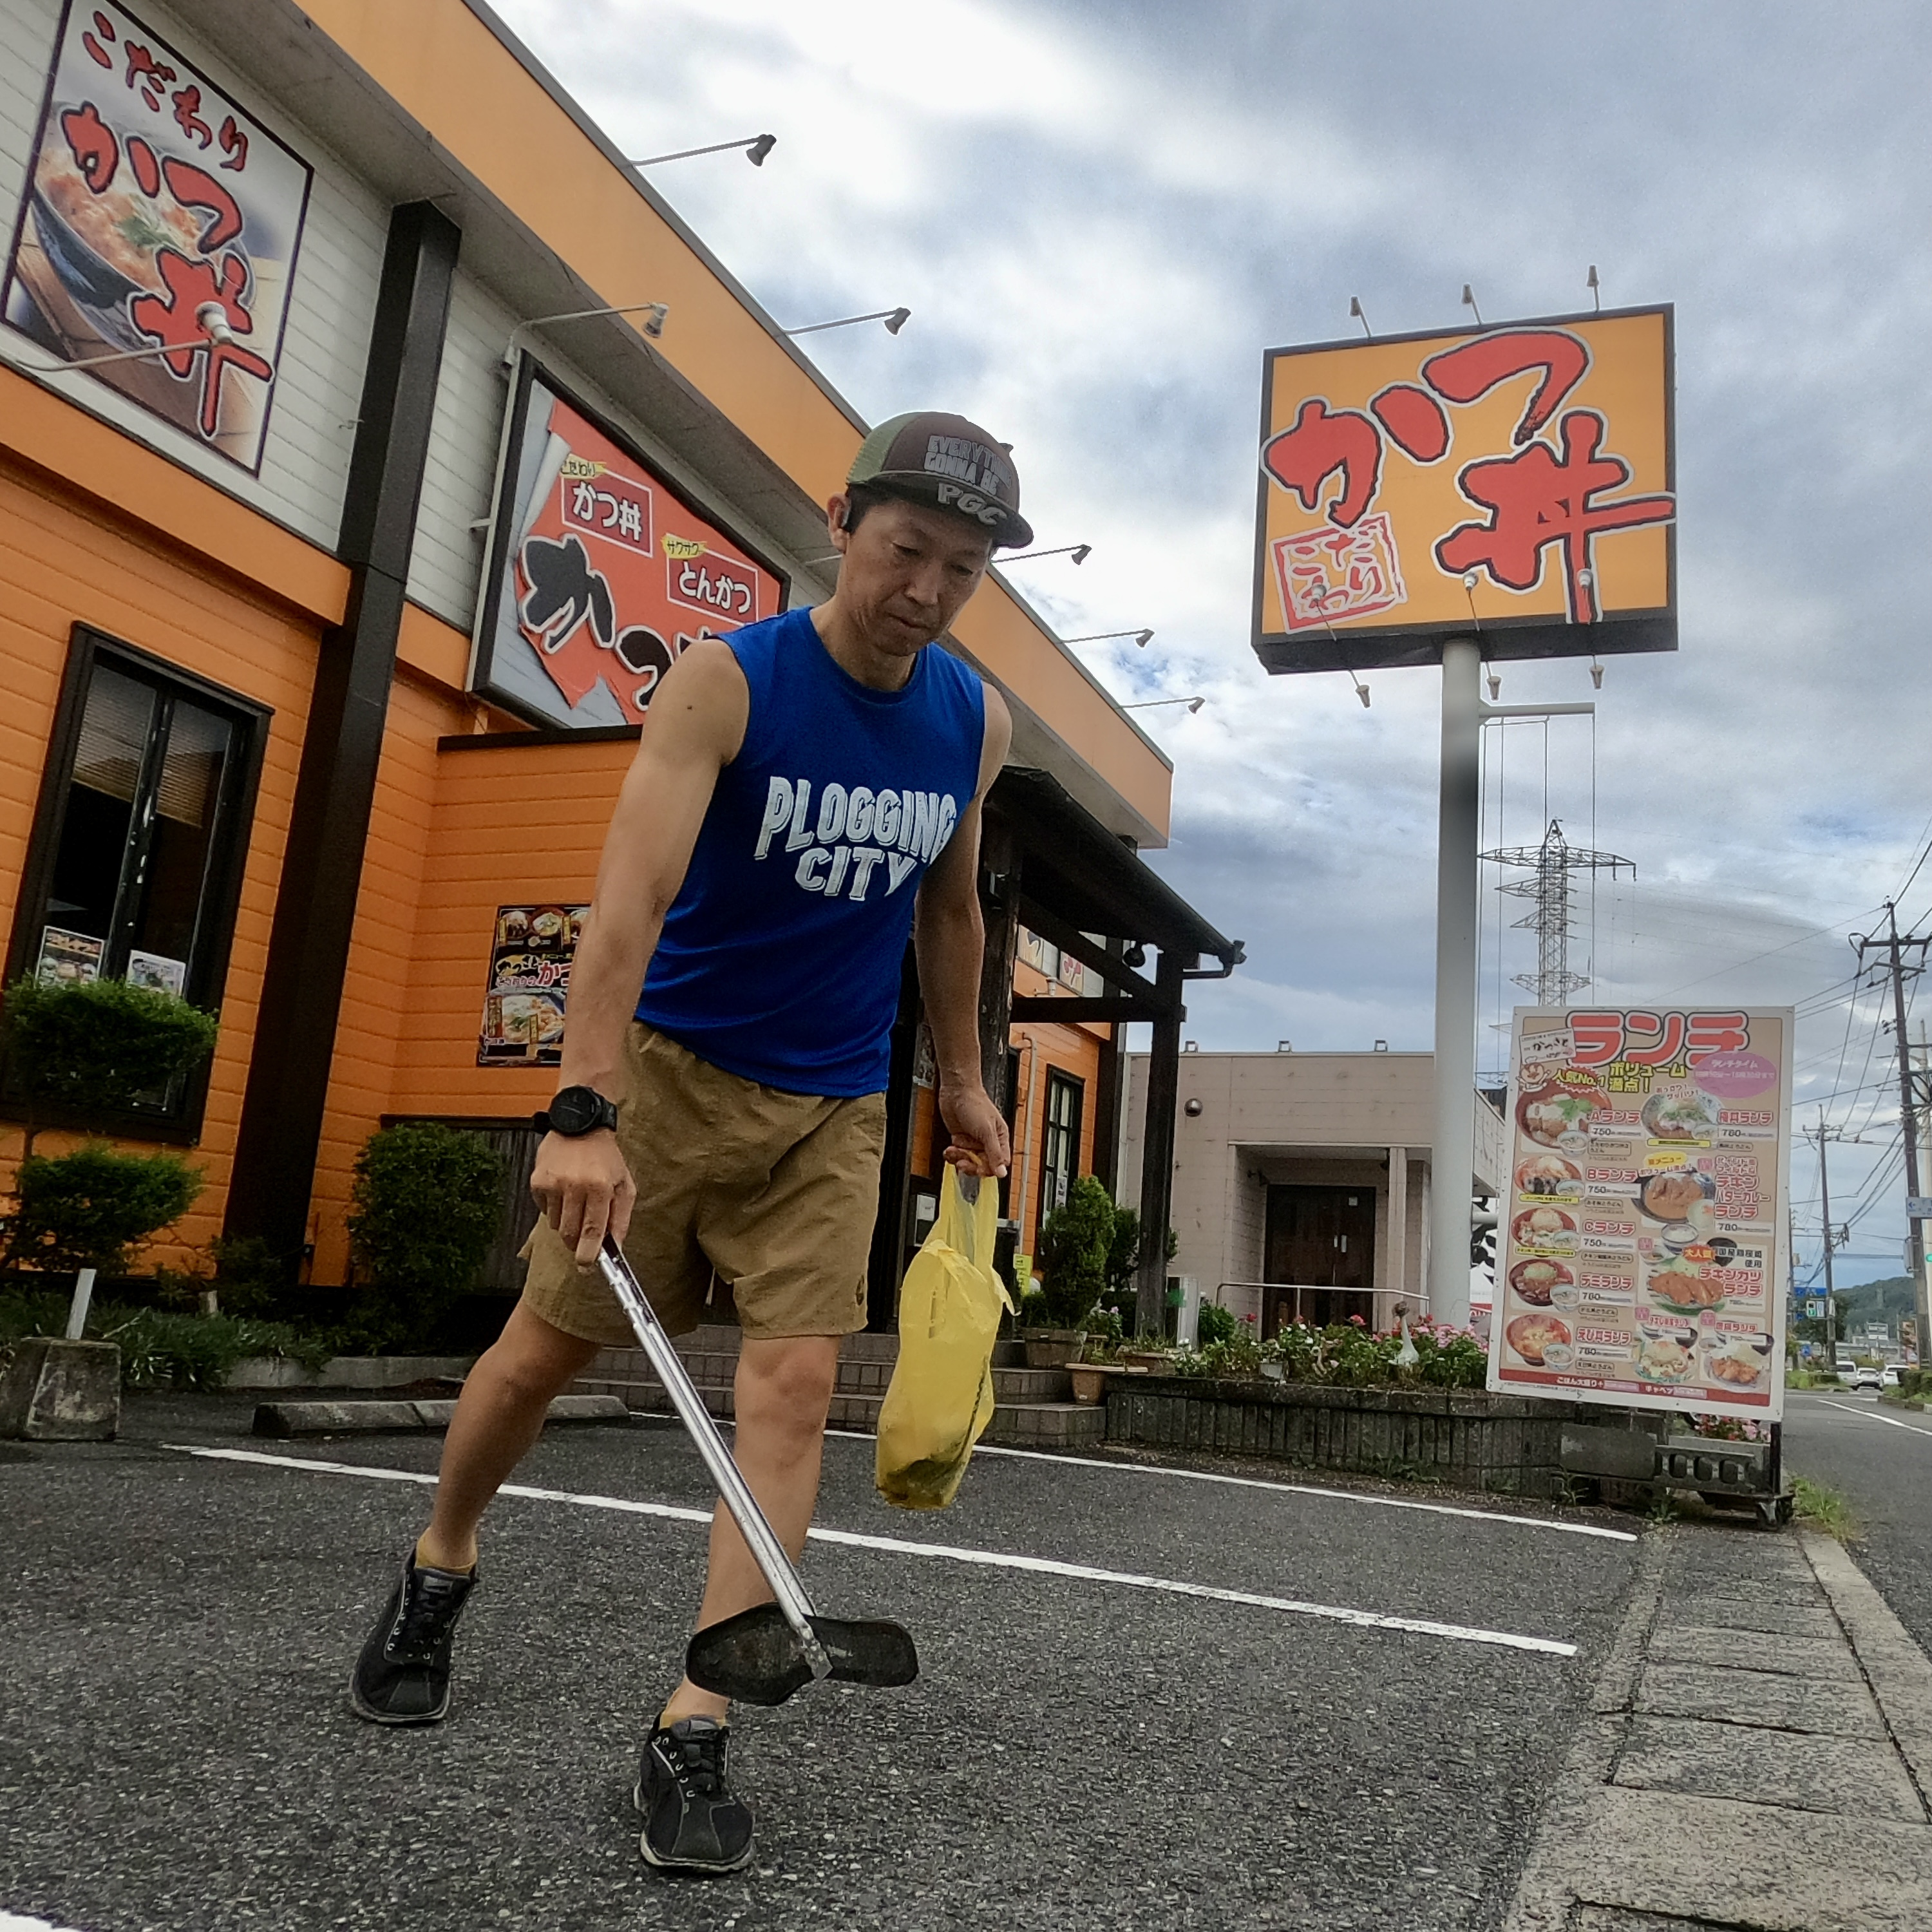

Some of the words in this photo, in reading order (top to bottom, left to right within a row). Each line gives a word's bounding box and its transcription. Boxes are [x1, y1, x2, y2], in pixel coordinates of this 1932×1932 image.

[82, 10, 249, 171] こだわり
[61, 100, 275, 438] かつ丼
[923, 451, 977, 484] GONNA
[980, 468, 999, 496] BE
[927, 435, 1012, 489] EVERYTHING
[1260, 327, 1674, 623] かつ丼
[572, 480, 643, 542] かつ丼
[938, 482, 1008, 526] PGC
[667, 540, 699, 555] サクサク
[678, 560, 752, 614] とんかつ
[519, 533, 716, 711] かつ
[753, 776, 957, 867] PLOGGING
[795, 846, 918, 902] CITY
[1566, 1010, 1750, 1068] ランチ
[1552, 1068, 1605, 1087] 人気No.1
[1609, 1061, 1687, 1079] ボリューム
[1589, 1108, 1642, 1124] Aランチ
[1586, 1168, 1638, 1183] Bランチ
[1715, 1175, 1759, 1191] チキン
[1715, 1188, 1771, 1204] バターカレー
[1583, 1219, 1636, 1235] Cランチ
[1714, 1205, 1758, 1220] ランチ
[1580, 1273, 1634, 1291] デミランチ
[1700, 1267, 1763, 1283] チキンカツ
[1723, 1283, 1763, 1297] ランチ
